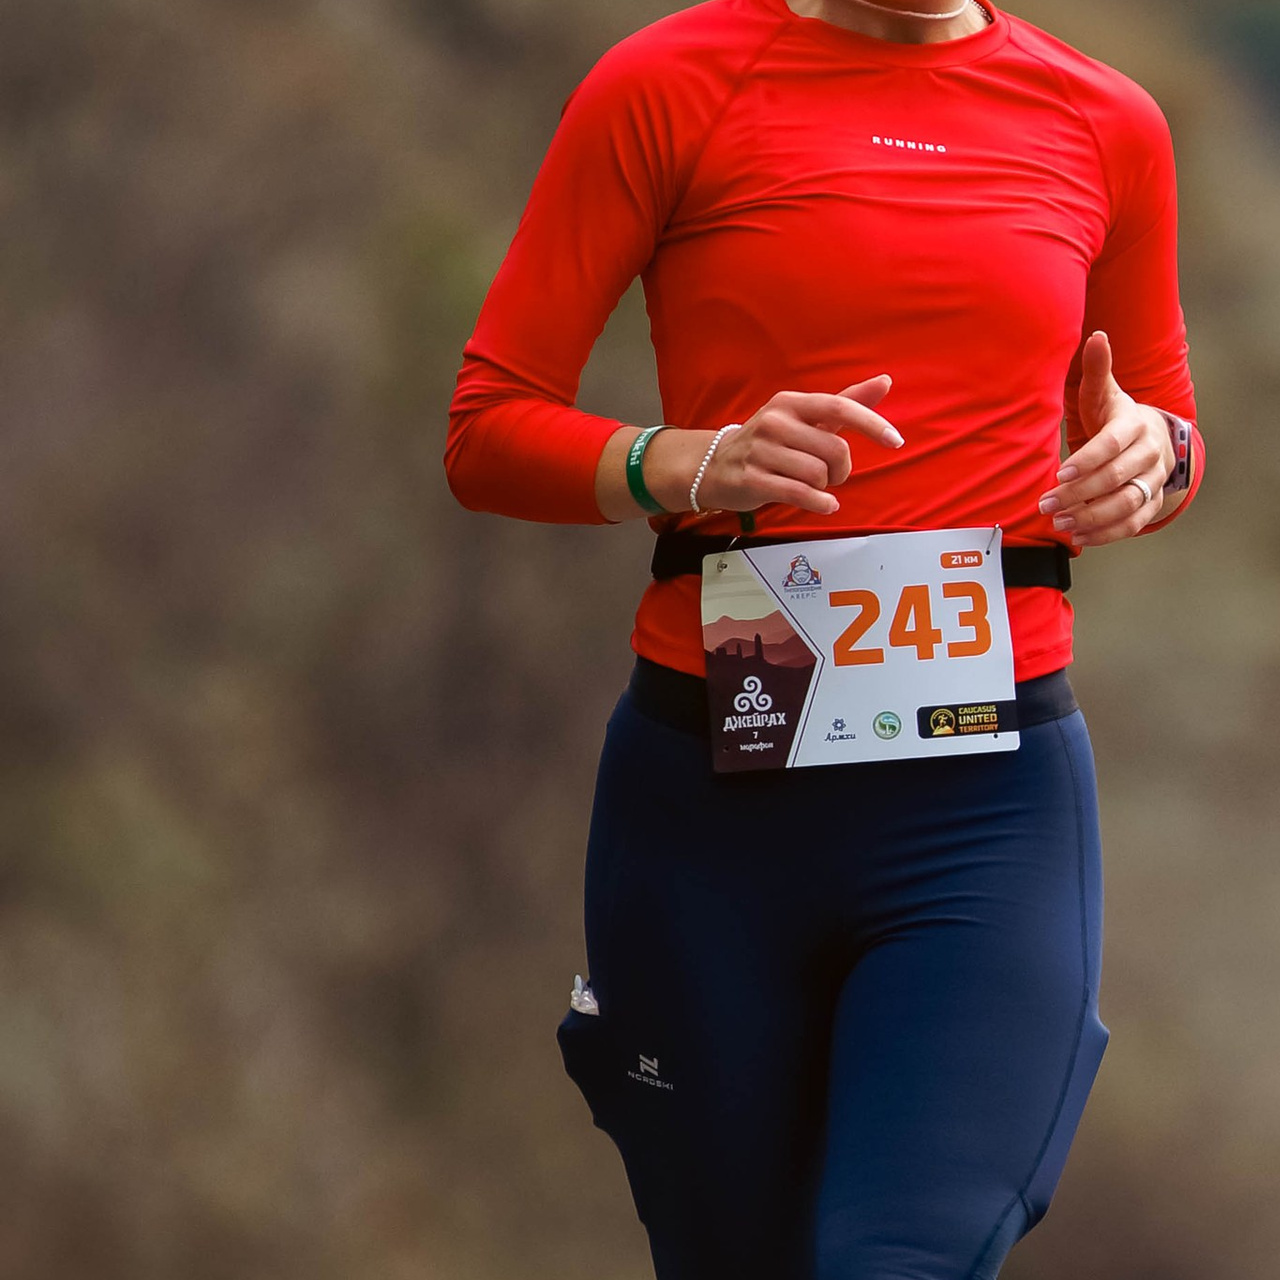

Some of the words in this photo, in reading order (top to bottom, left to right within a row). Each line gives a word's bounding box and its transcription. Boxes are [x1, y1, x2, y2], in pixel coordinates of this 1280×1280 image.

[872, 136, 946, 152] RUNNING
[951, 555, 962, 565] 21
[829, 581, 992, 666] 243
[958, 705, 997, 714] CAUCASUS
[723, 712, 787, 732] ДЖЕЙРАХ
[959, 713, 998, 724] UNITED
[958, 724, 998, 733] TERRITORY
[628, 1072, 674, 1090] NORDSKI
